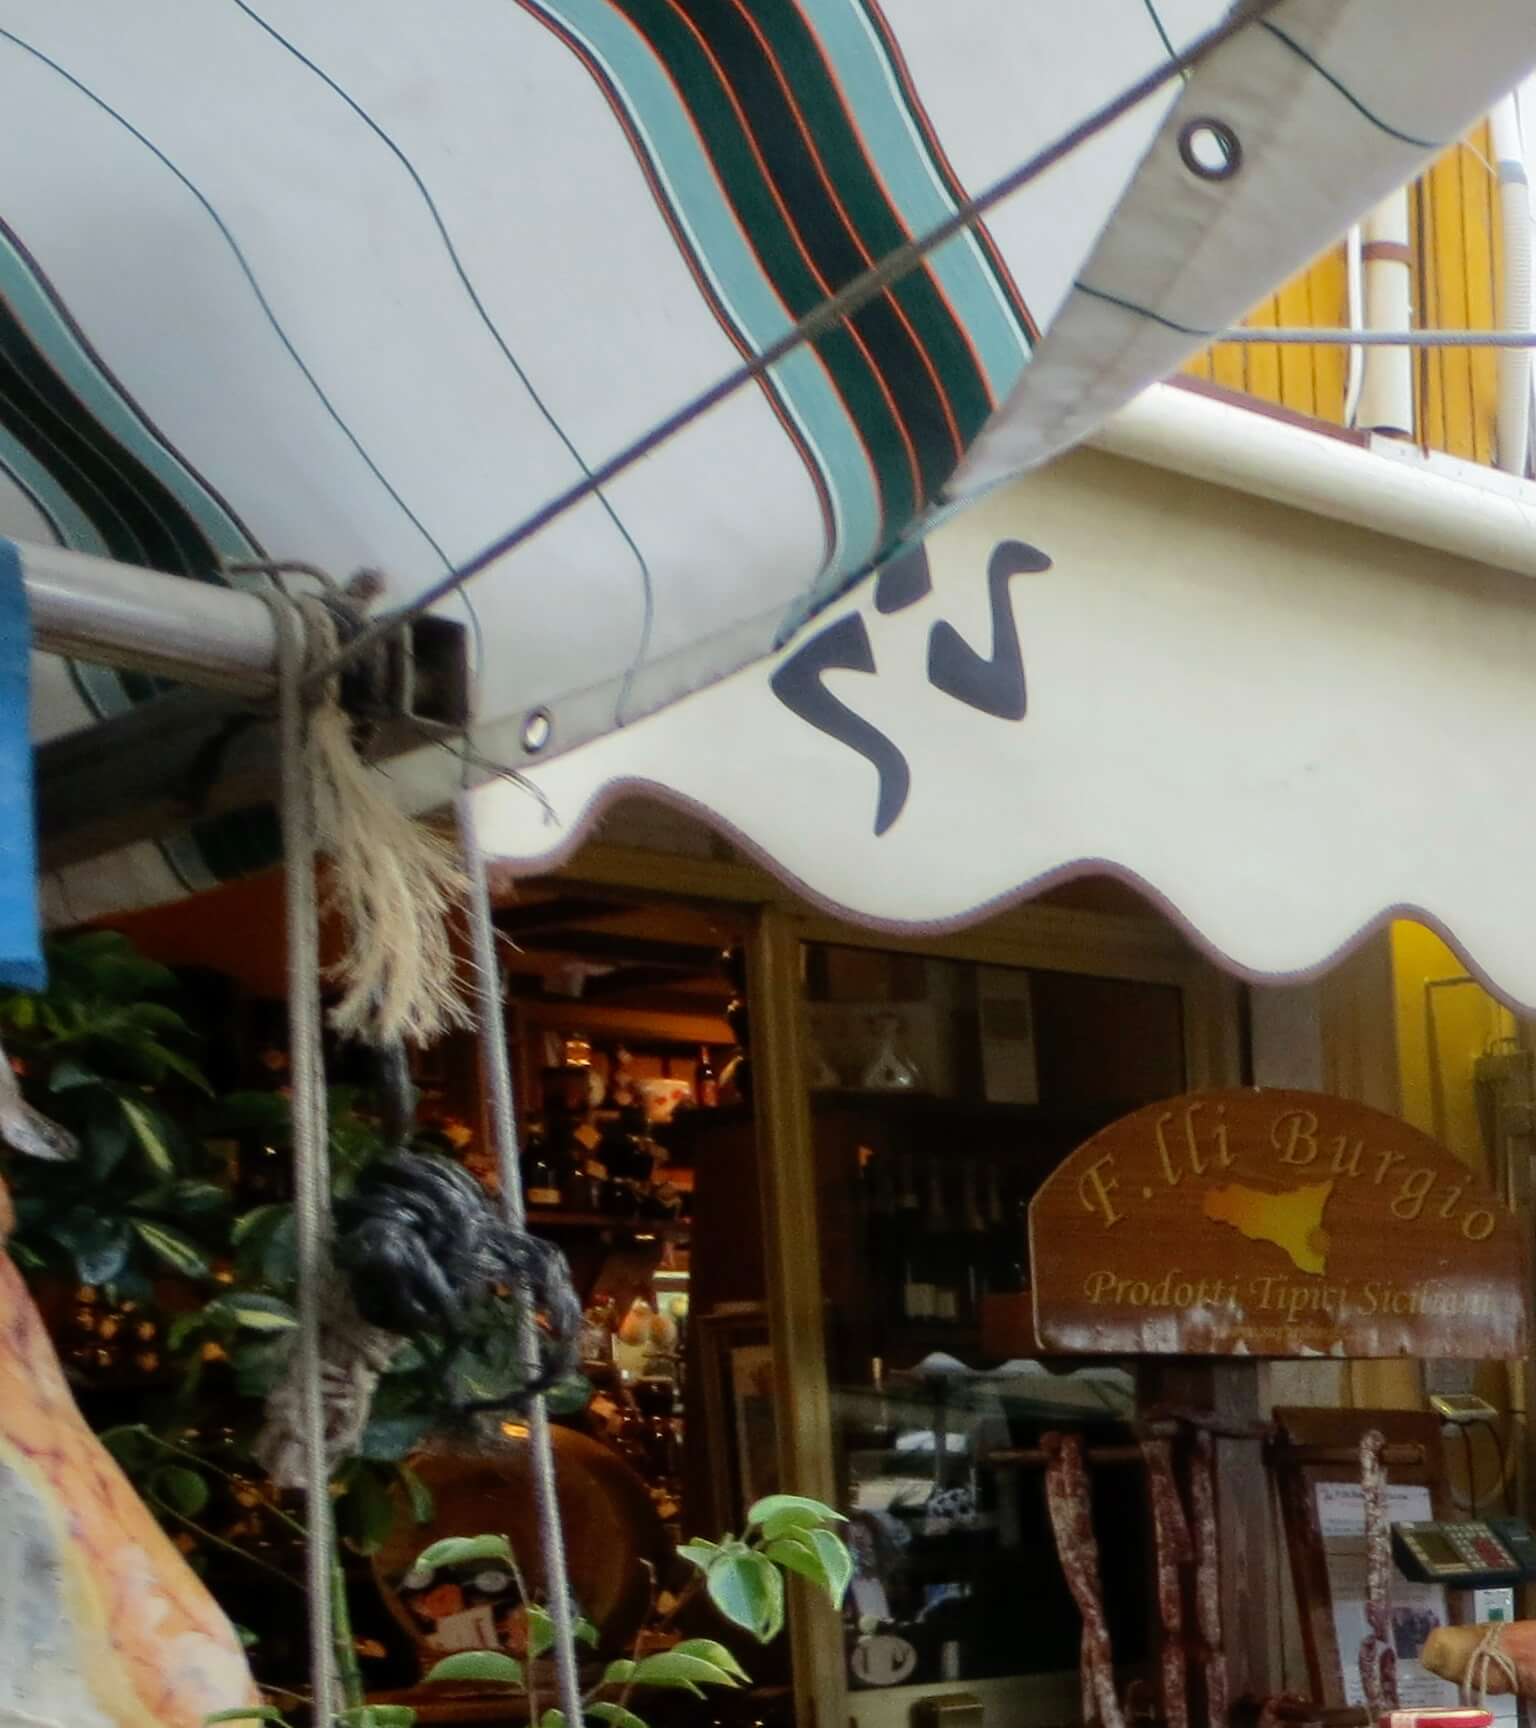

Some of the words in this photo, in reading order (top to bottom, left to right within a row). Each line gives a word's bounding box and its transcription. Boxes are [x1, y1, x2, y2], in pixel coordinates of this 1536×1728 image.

[1078, 1102, 1239, 1228] F.lli
[1271, 1109, 1496, 1241] Burgio
[1084, 1270, 1239, 1308] Prodotti
